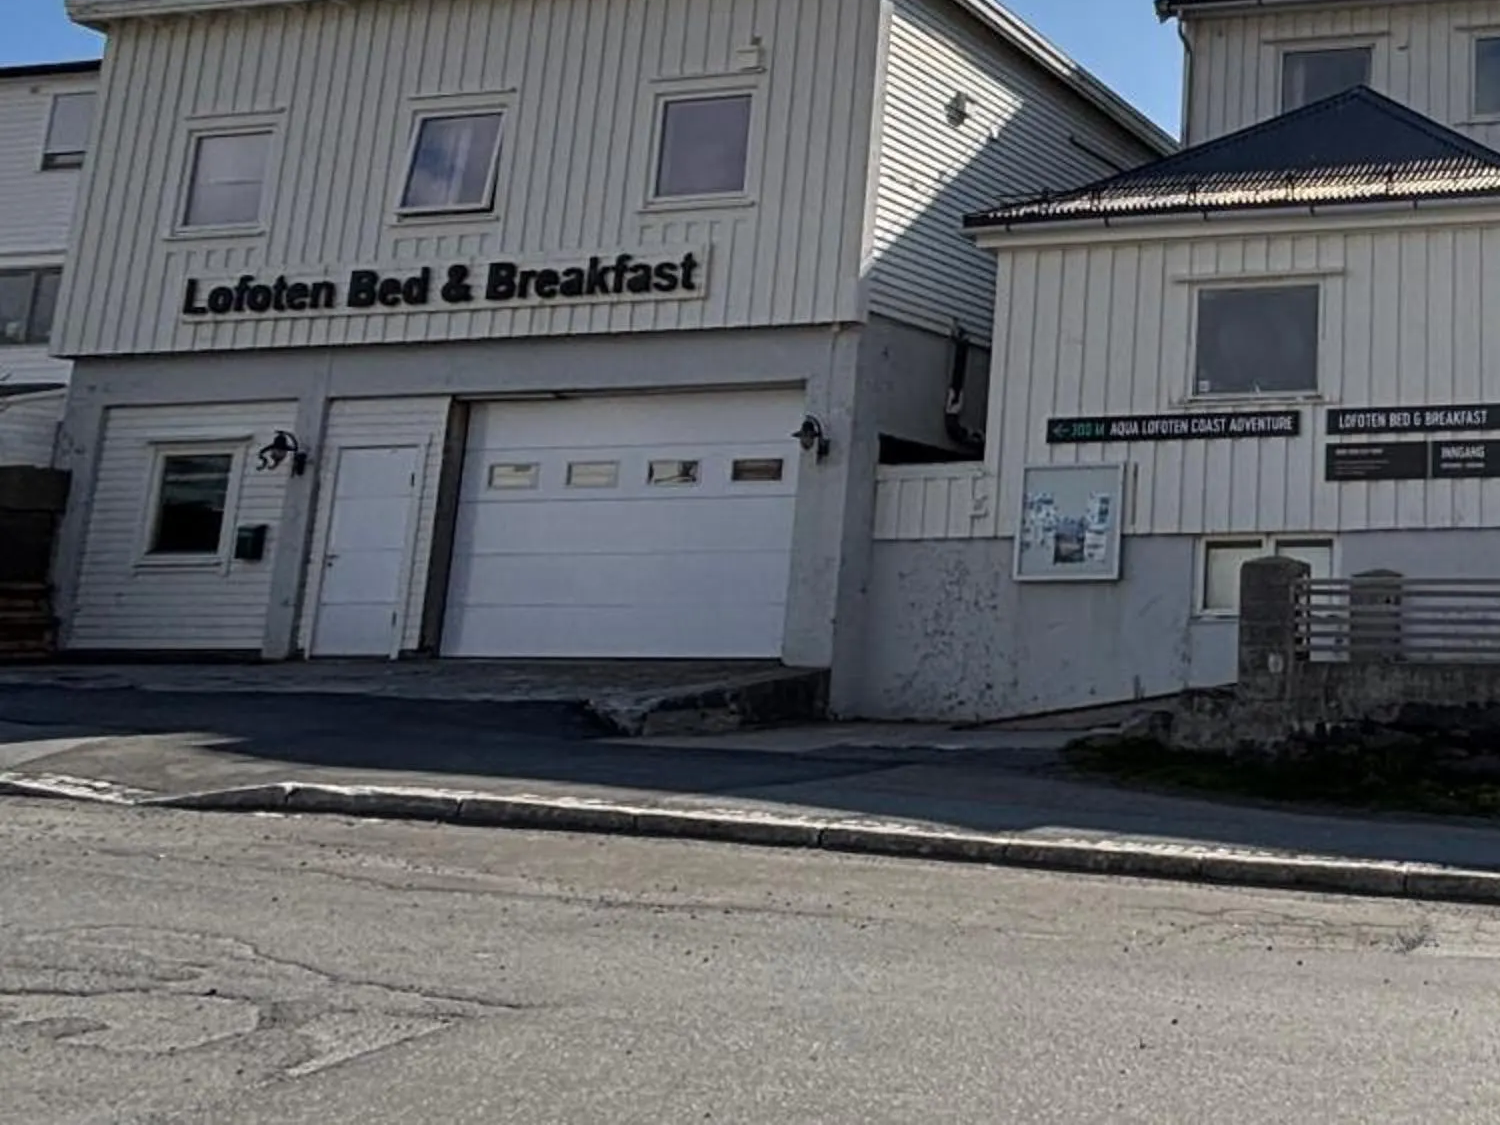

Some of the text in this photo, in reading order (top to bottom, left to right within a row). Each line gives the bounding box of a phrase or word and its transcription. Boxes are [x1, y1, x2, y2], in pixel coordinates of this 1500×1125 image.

[183, 252, 698, 315] Lofoten Bed & Breakfast
[1109, 420, 1138, 436] AQUA
[1141, 418, 1188, 435] LOFOTEN
[1191, 417, 1225, 433] COAST
[1229, 415, 1293, 432] ADVENTURE
[1339, 412, 1387, 428] LOFOTEN
[1389, 412, 1411, 427] BED
[1424, 409, 1487, 426] BREAKFAST
